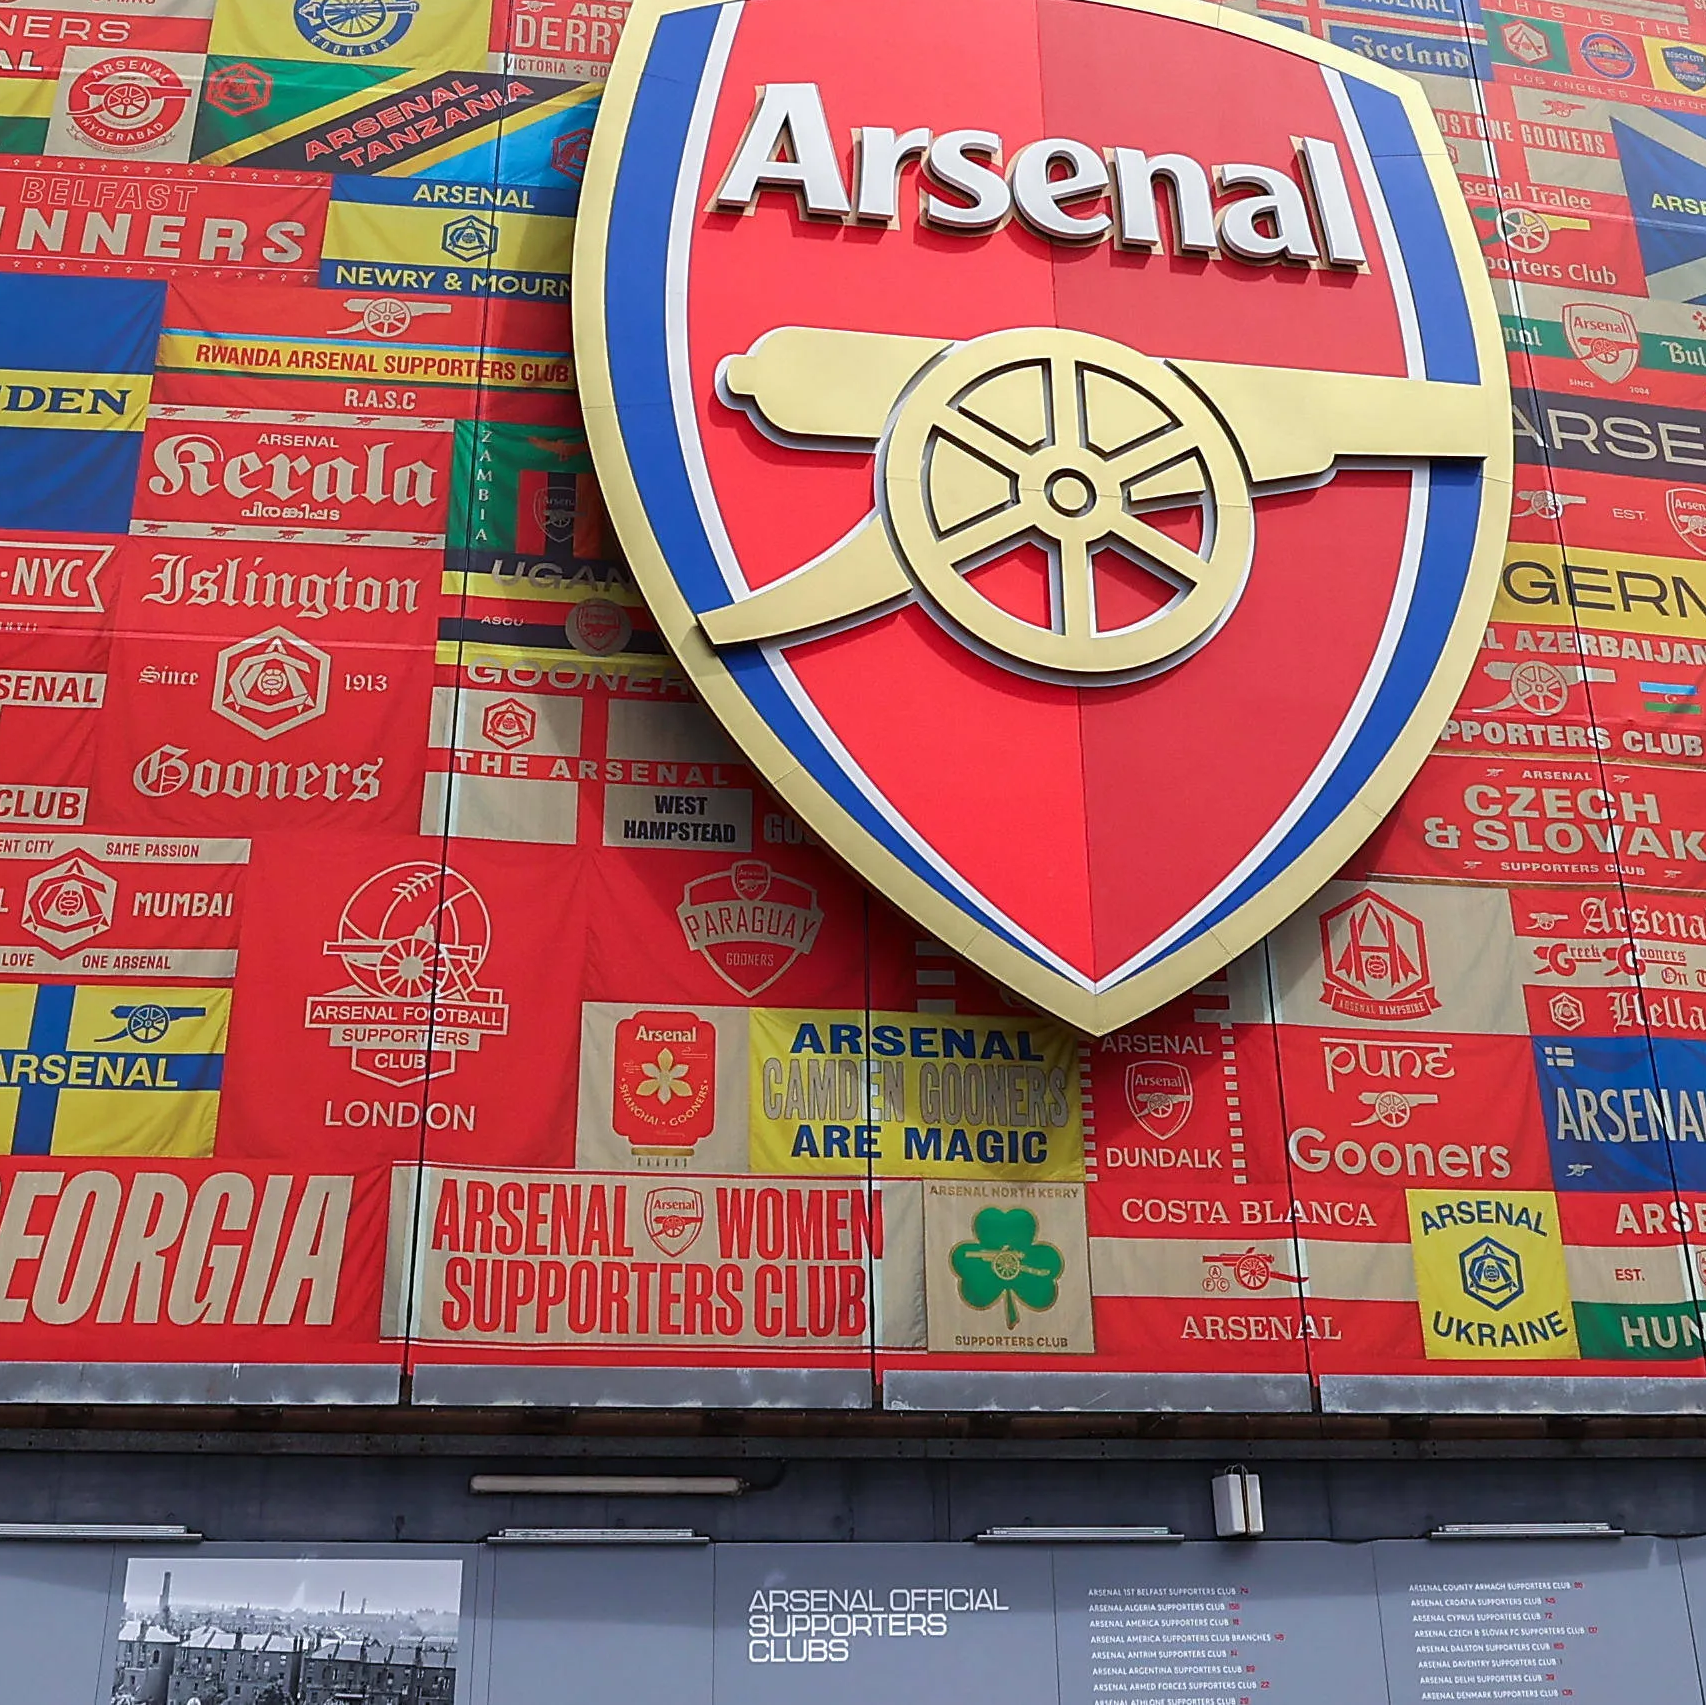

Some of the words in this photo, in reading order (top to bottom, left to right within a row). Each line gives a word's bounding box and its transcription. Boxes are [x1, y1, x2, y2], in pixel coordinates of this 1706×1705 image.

[715, 81, 1369, 268] Arsenal
[19, 177, 197, 212] BELFAST
[344, 388, 417, 411] R.A.S.C
[147, 432, 440, 508] Kerala
[344, 672, 388, 692] 1913
[654, 795, 708, 817] WEST
[622, 818, 737, 844] HAMPSTEAD
[23, 840, 55, 854] CITY
[105, 841, 141, 857] SAME
[144, 842, 200, 858] PASSION
[133, 893, 233, 918] MUMBAI
[324, 1100, 476, 1132] LONDON
[1104, 1146, 1224, 1170] DUNDALK
[1288, 1128, 1512, 1178] Gooners
[430, 1179, 634, 1256] ARSENAL
[716, 1187, 884, 1260] WOMEN
[1121, 1198, 1230, 1225] COSTA
[1239, 1200, 1378, 1228] BLANCA
[441, 1256, 744, 1335] SUPPORTERS
[753, 1265, 868, 1338] CLUB
[1432, 1310, 1568, 1348] UKRAINE
[748, 1589, 884, 1612] ARSENAL
[889, 1588, 1009, 1612] OFFICIAL
[749, 1614, 948, 1638] SUPPORTERS
[1161, 1619, 1208, 1627] SUPPORTERS
[749, 1639, 849, 1663] CLUBS
